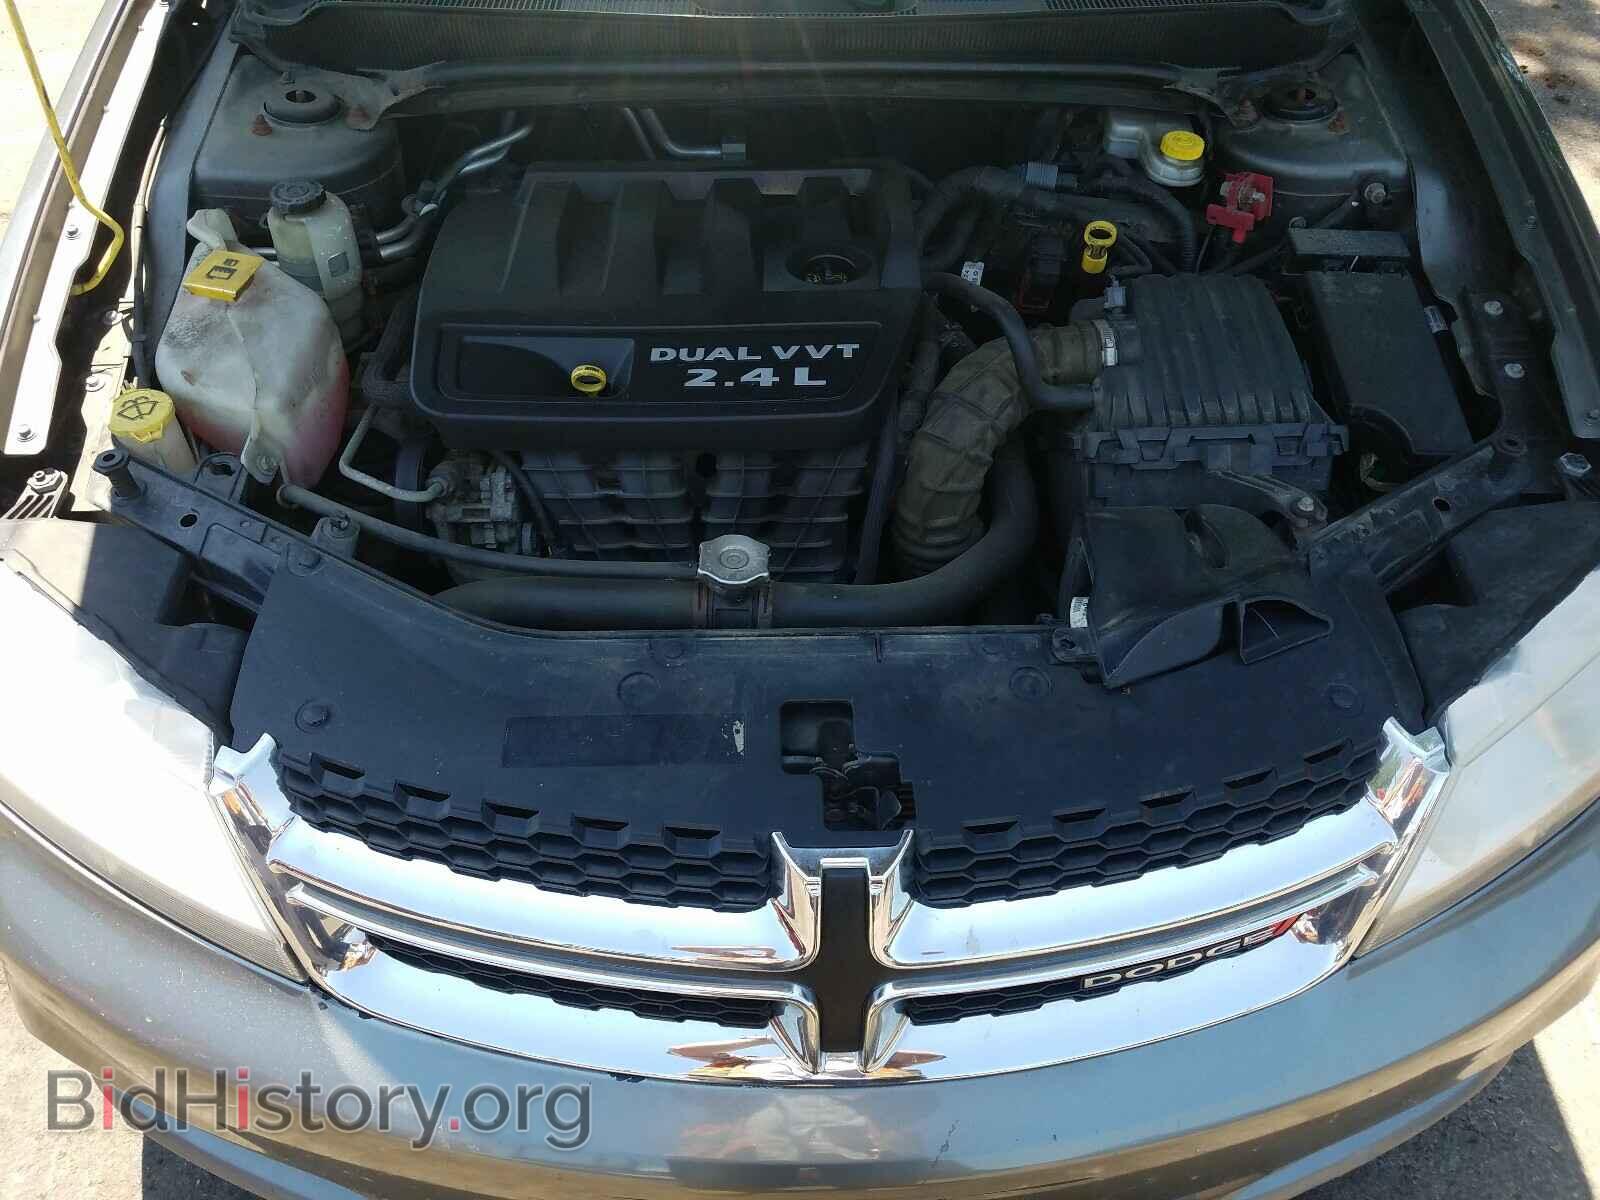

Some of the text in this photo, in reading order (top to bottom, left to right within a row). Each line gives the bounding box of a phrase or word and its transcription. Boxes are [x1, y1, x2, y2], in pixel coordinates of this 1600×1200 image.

[650, 343, 860, 362] DUAL VVT
[1083, 926, 1275, 990] DODGE
